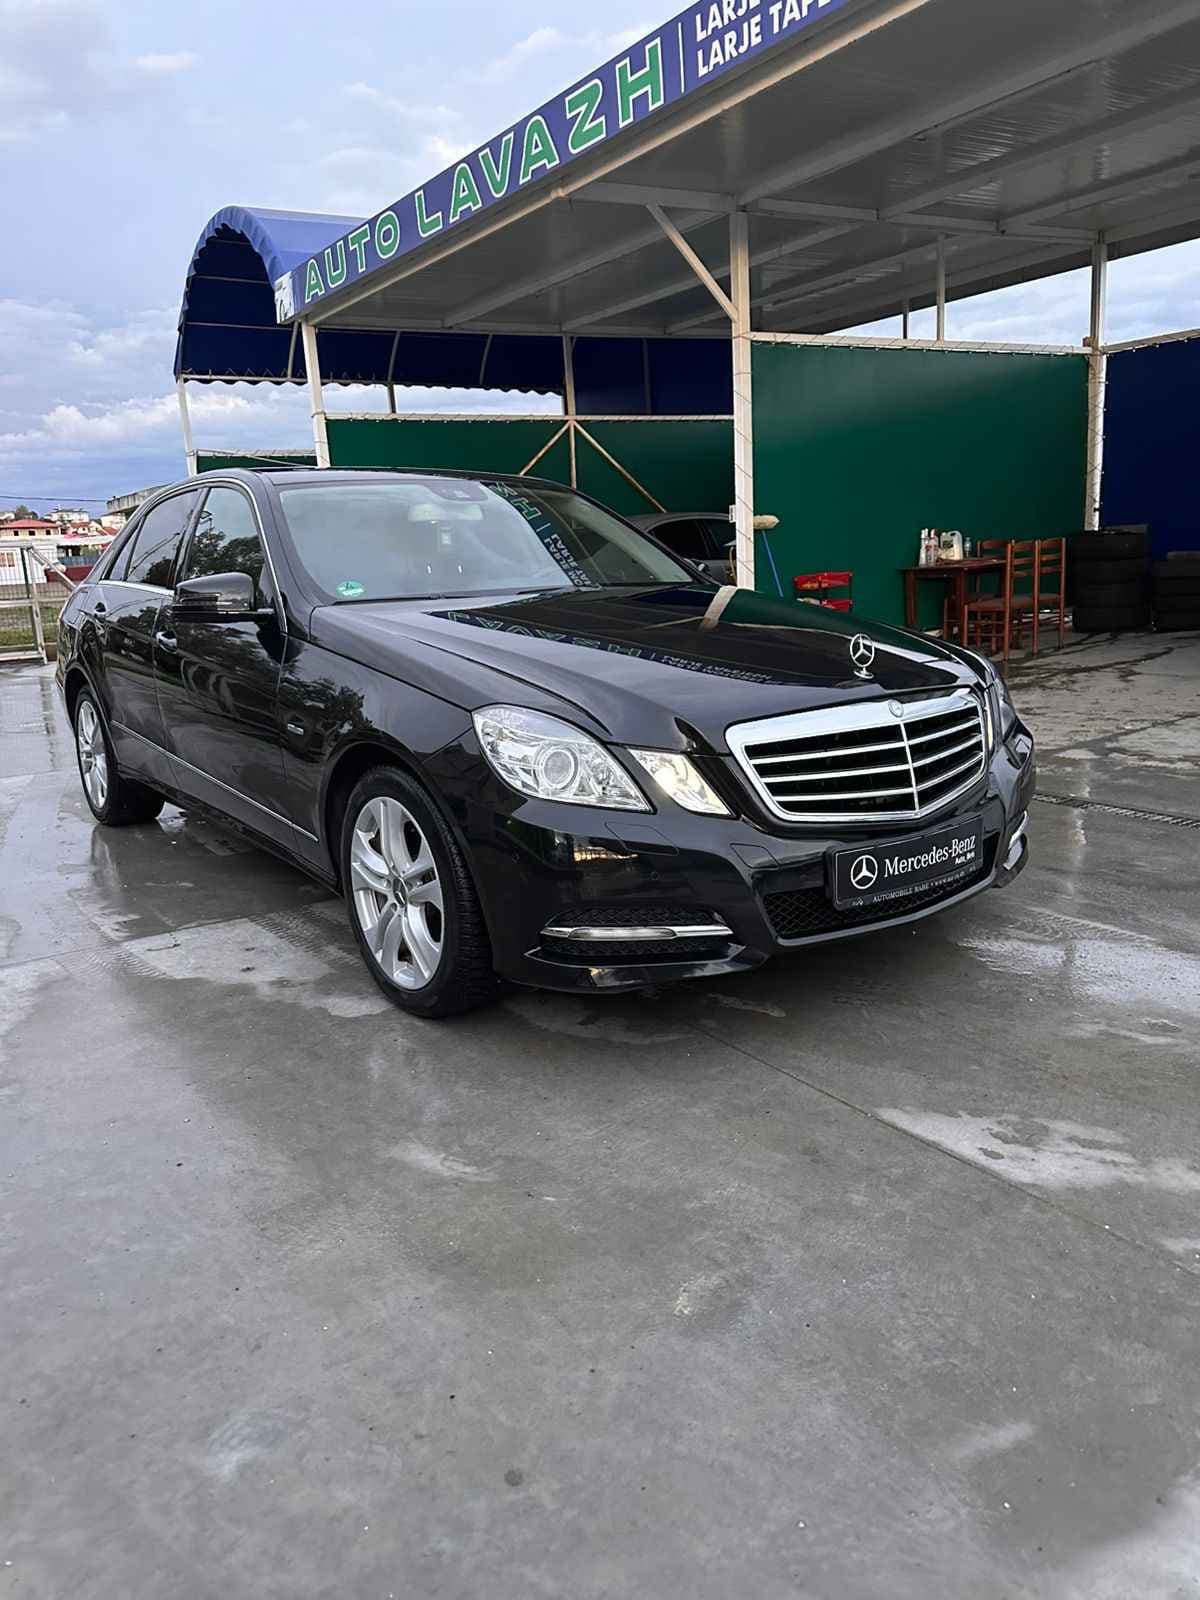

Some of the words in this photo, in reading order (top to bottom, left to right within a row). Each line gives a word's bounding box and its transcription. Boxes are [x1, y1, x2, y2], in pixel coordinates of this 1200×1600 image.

[697, 14, 762, 77] LARJE
[769, 0, 832, 34] TAP
[304, 211, 400, 303] AUTO
[415, 37, 664, 238] LAVAZH
[883, 835, 976, 878] Mercedes-Benz
